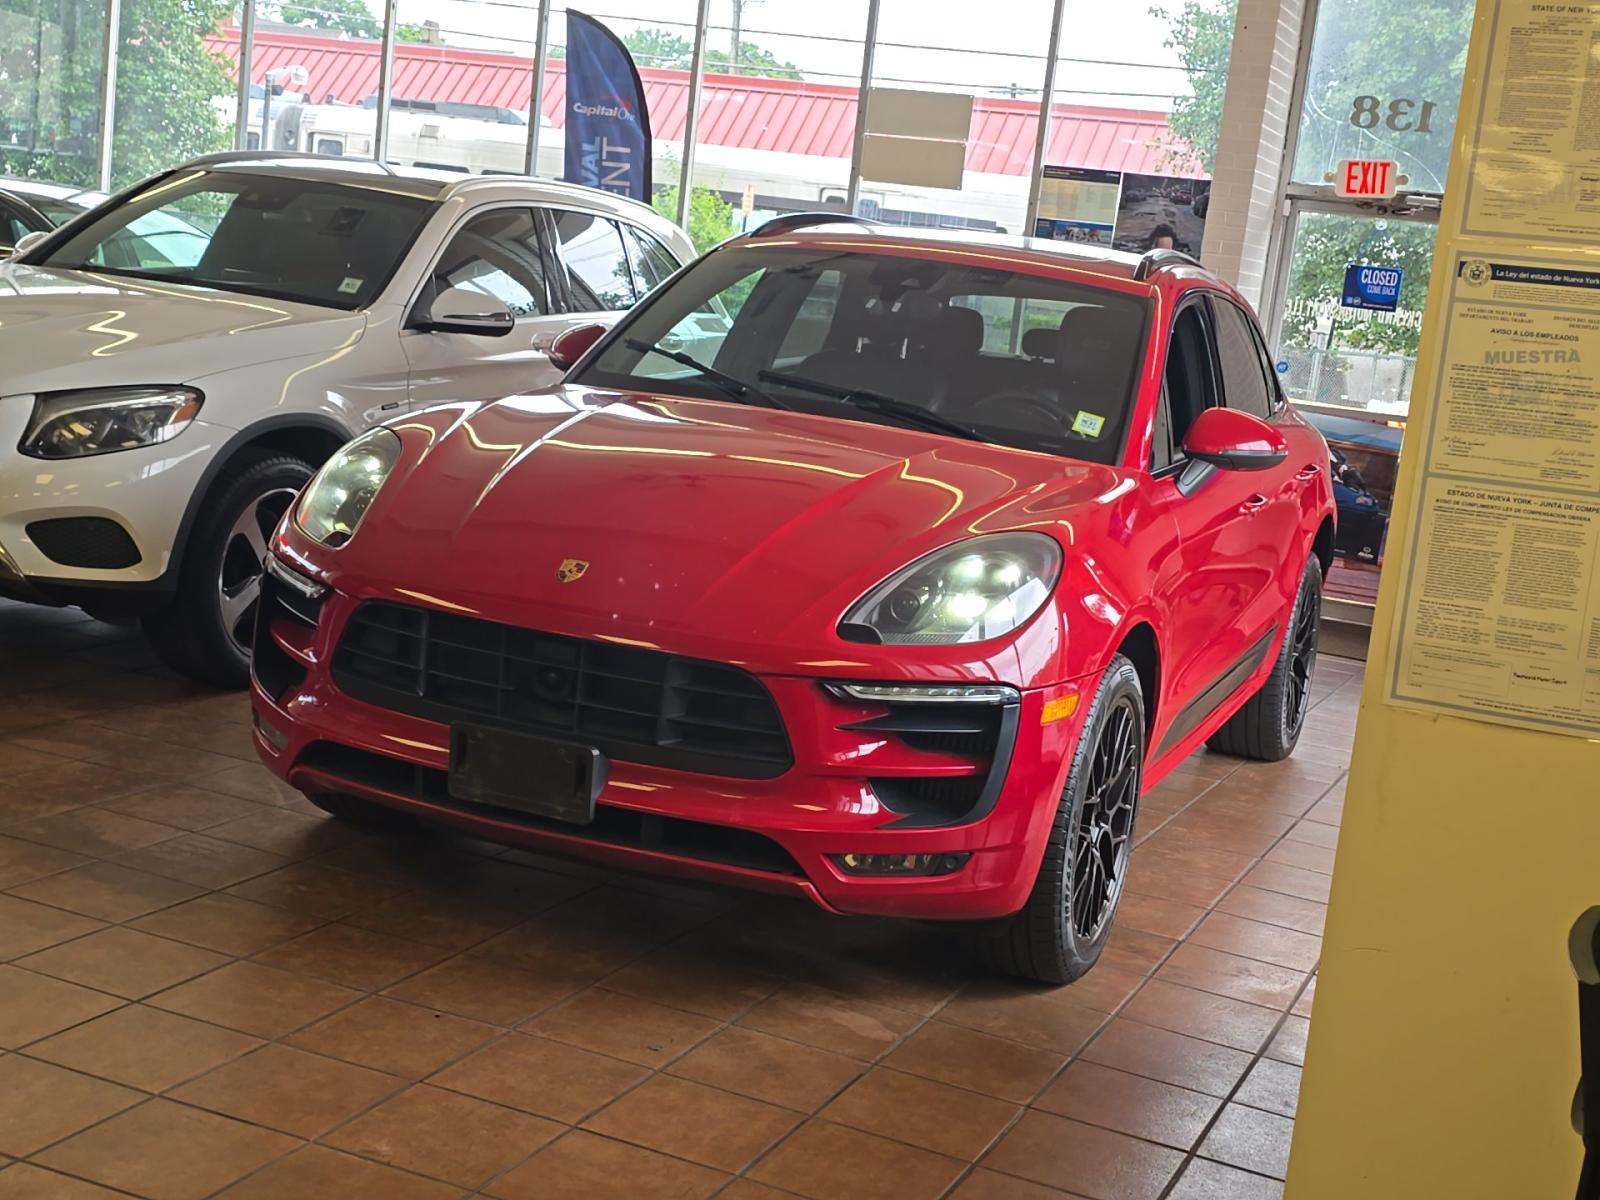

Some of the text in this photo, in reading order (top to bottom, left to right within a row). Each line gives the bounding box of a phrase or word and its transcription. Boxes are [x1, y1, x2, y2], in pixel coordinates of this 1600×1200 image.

[1346, 161, 1391, 195] EXIT
[1361, 269, 1398, 287] CLOSED
[1506, 270, 1517, 279] Ley
[1490, 328, 1512, 336] AVISO
[1520, 330, 1534, 338] LOS
[1535, 332, 1579, 342] EMPLEADOS
[1485, 349, 1581, 365] MUESTRA
[1447, 490, 1475, 498] ESTADO
[1487, 494, 1511, 502] NUEVA
